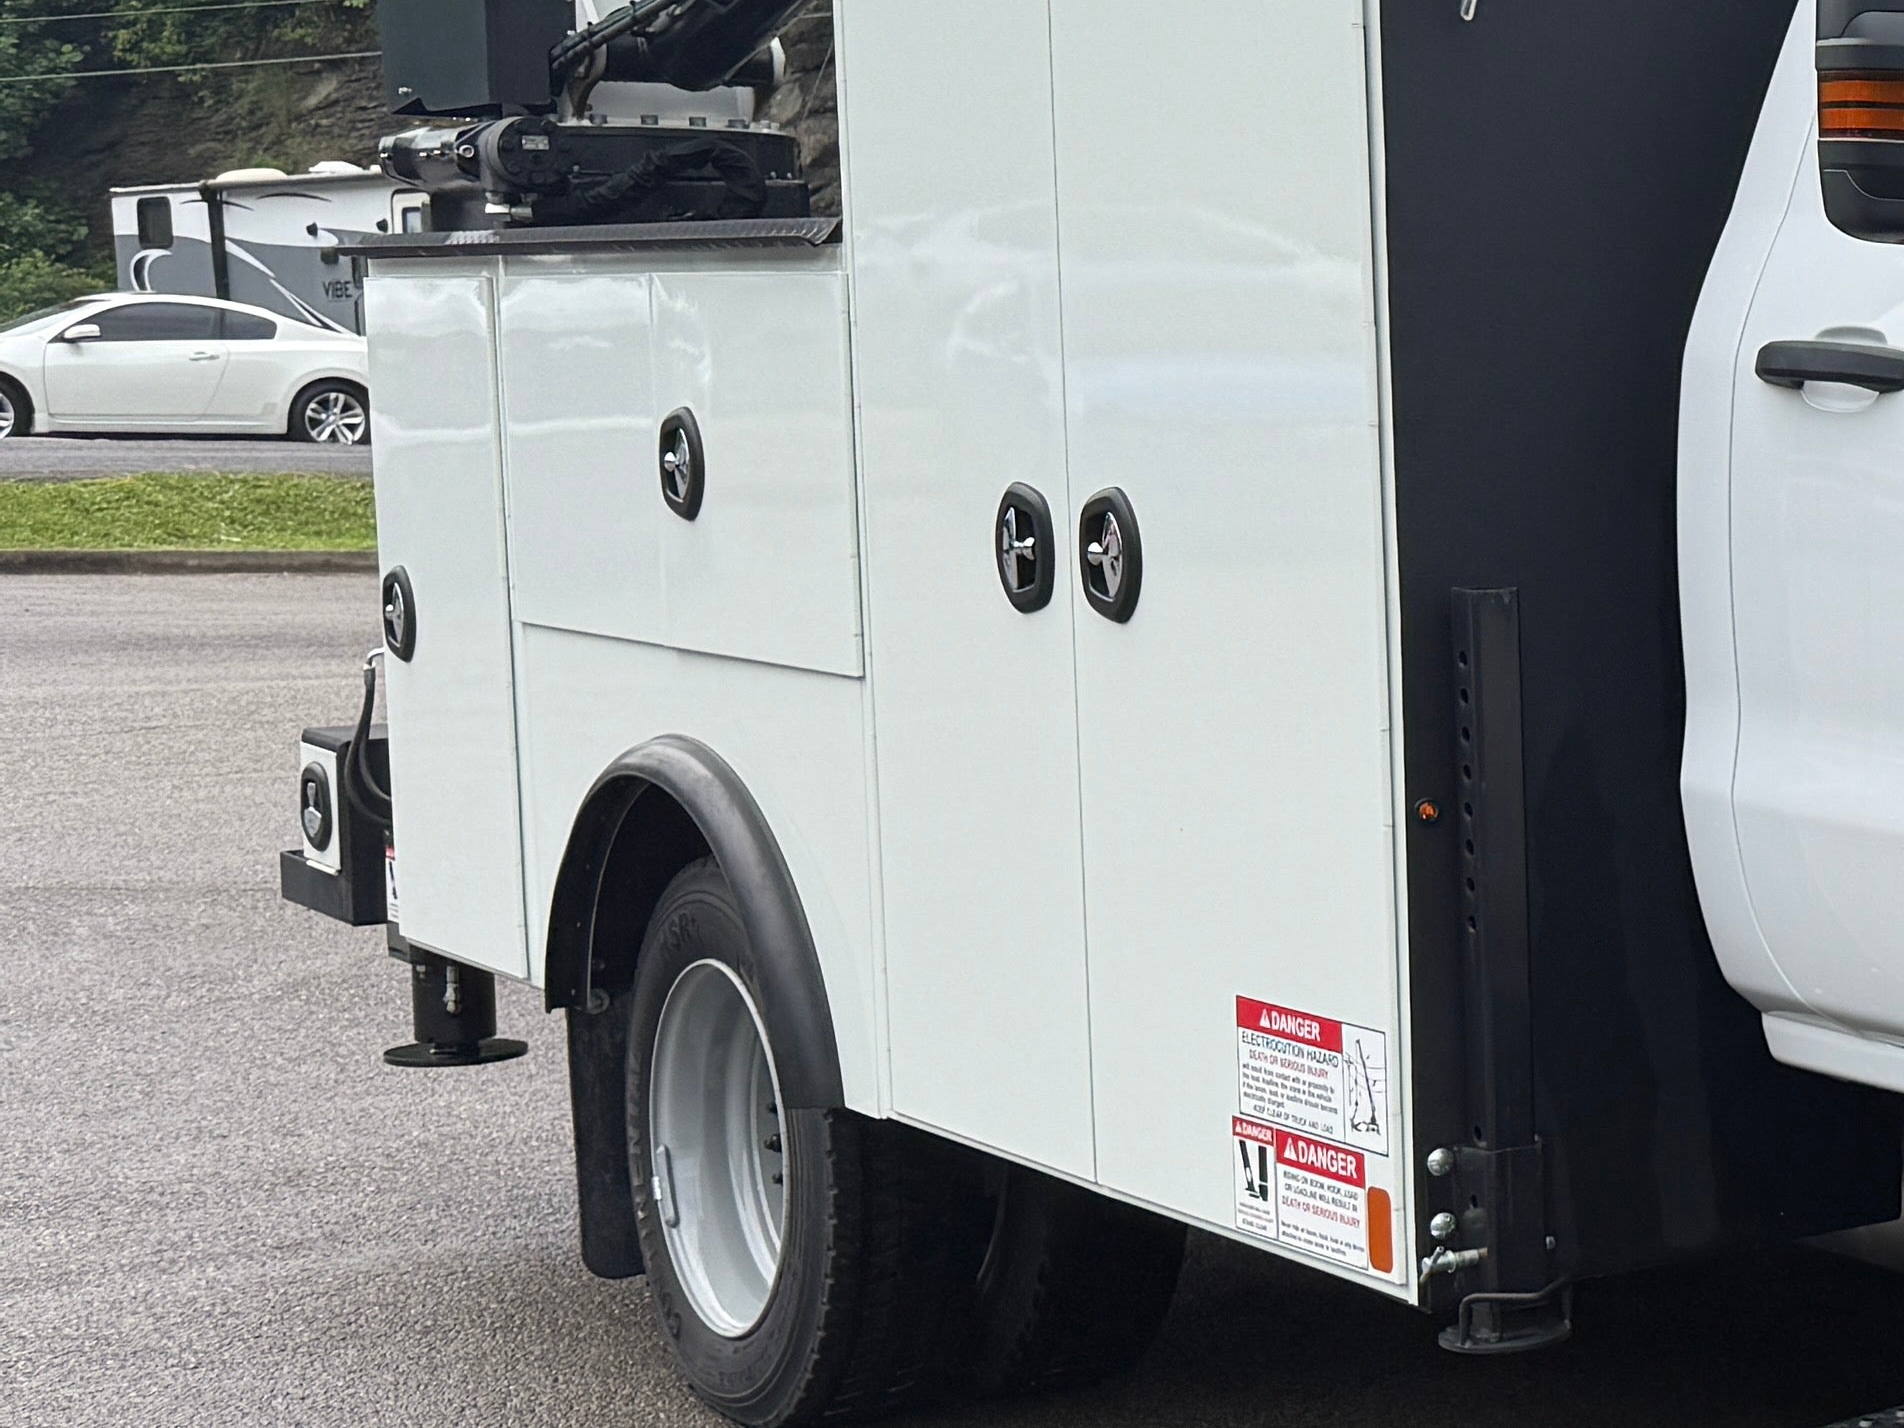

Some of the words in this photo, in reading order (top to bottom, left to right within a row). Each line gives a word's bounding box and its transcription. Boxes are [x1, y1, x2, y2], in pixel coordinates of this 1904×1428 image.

[321, 281, 352, 298] VIBE
[1271, 1010, 1321, 1042] DANGER
[1242, 1122, 1273, 1141] DANGER
[1297, 1140, 1358, 1179] DANGER
